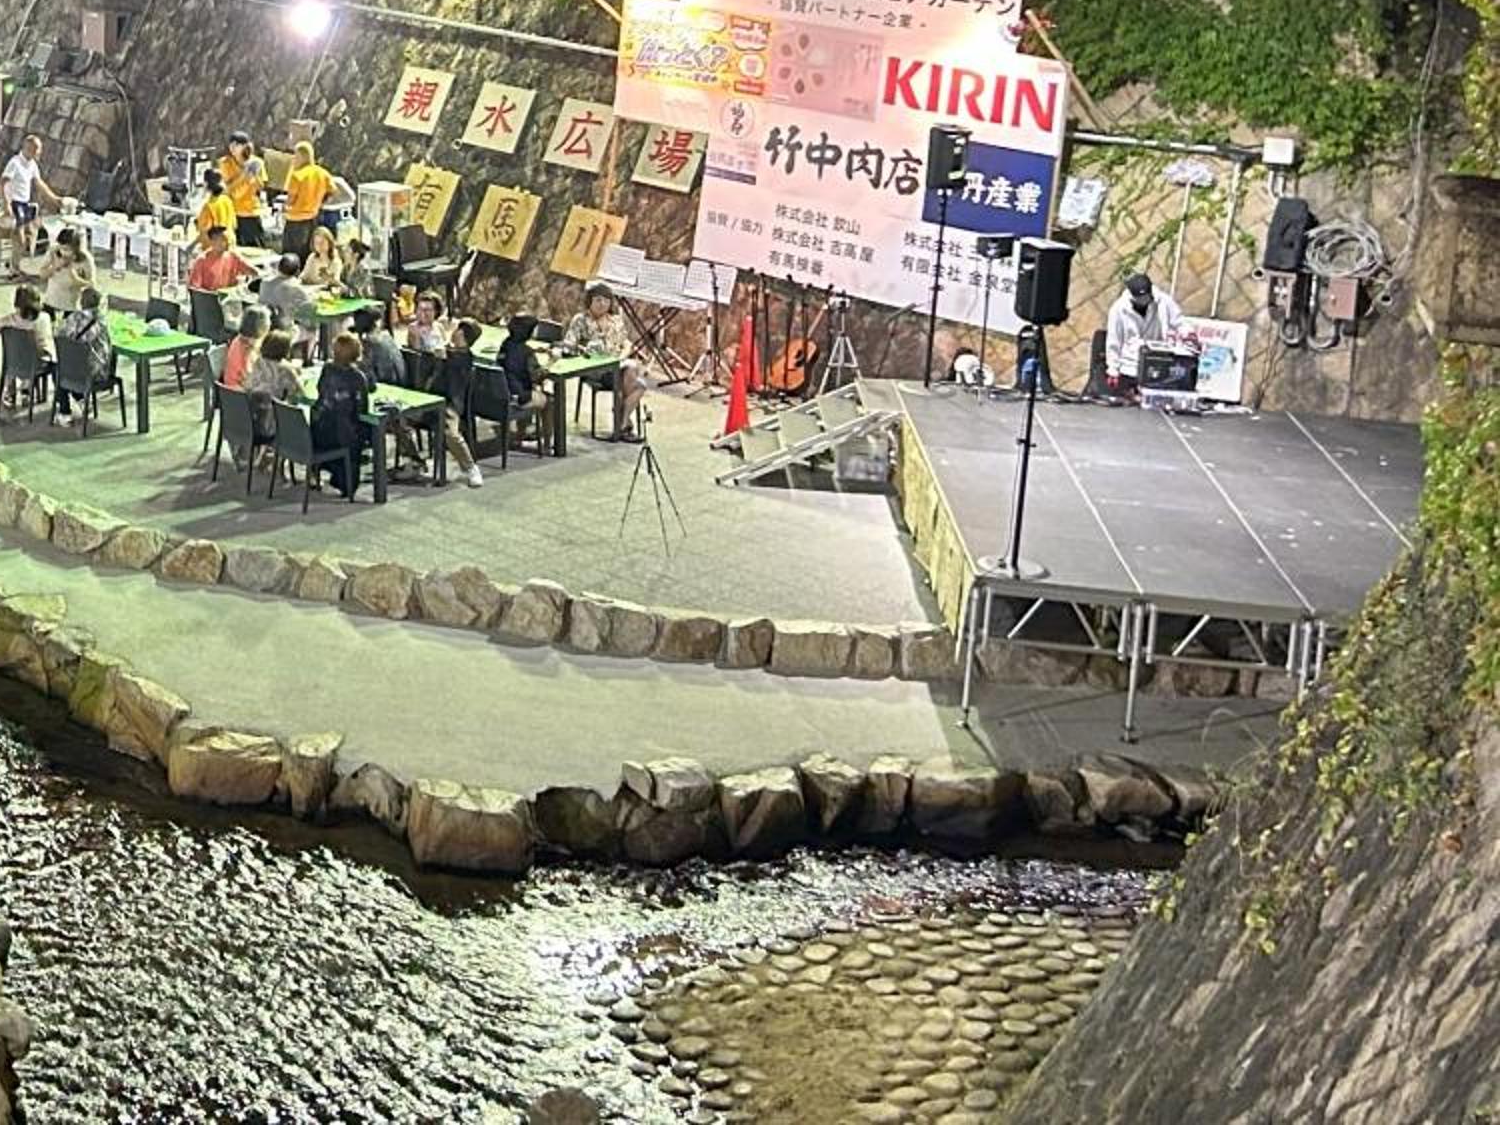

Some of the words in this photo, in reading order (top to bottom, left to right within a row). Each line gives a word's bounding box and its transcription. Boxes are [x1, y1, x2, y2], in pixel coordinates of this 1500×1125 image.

[883, 56, 1059, 134] KIRIN
[764, 125, 924, 195] 竹中肉店
[938, 171, 1043, 214] 丹産業
[775, 203, 830, 229] 株式会社
[771, 227, 826, 253] 株式会社
